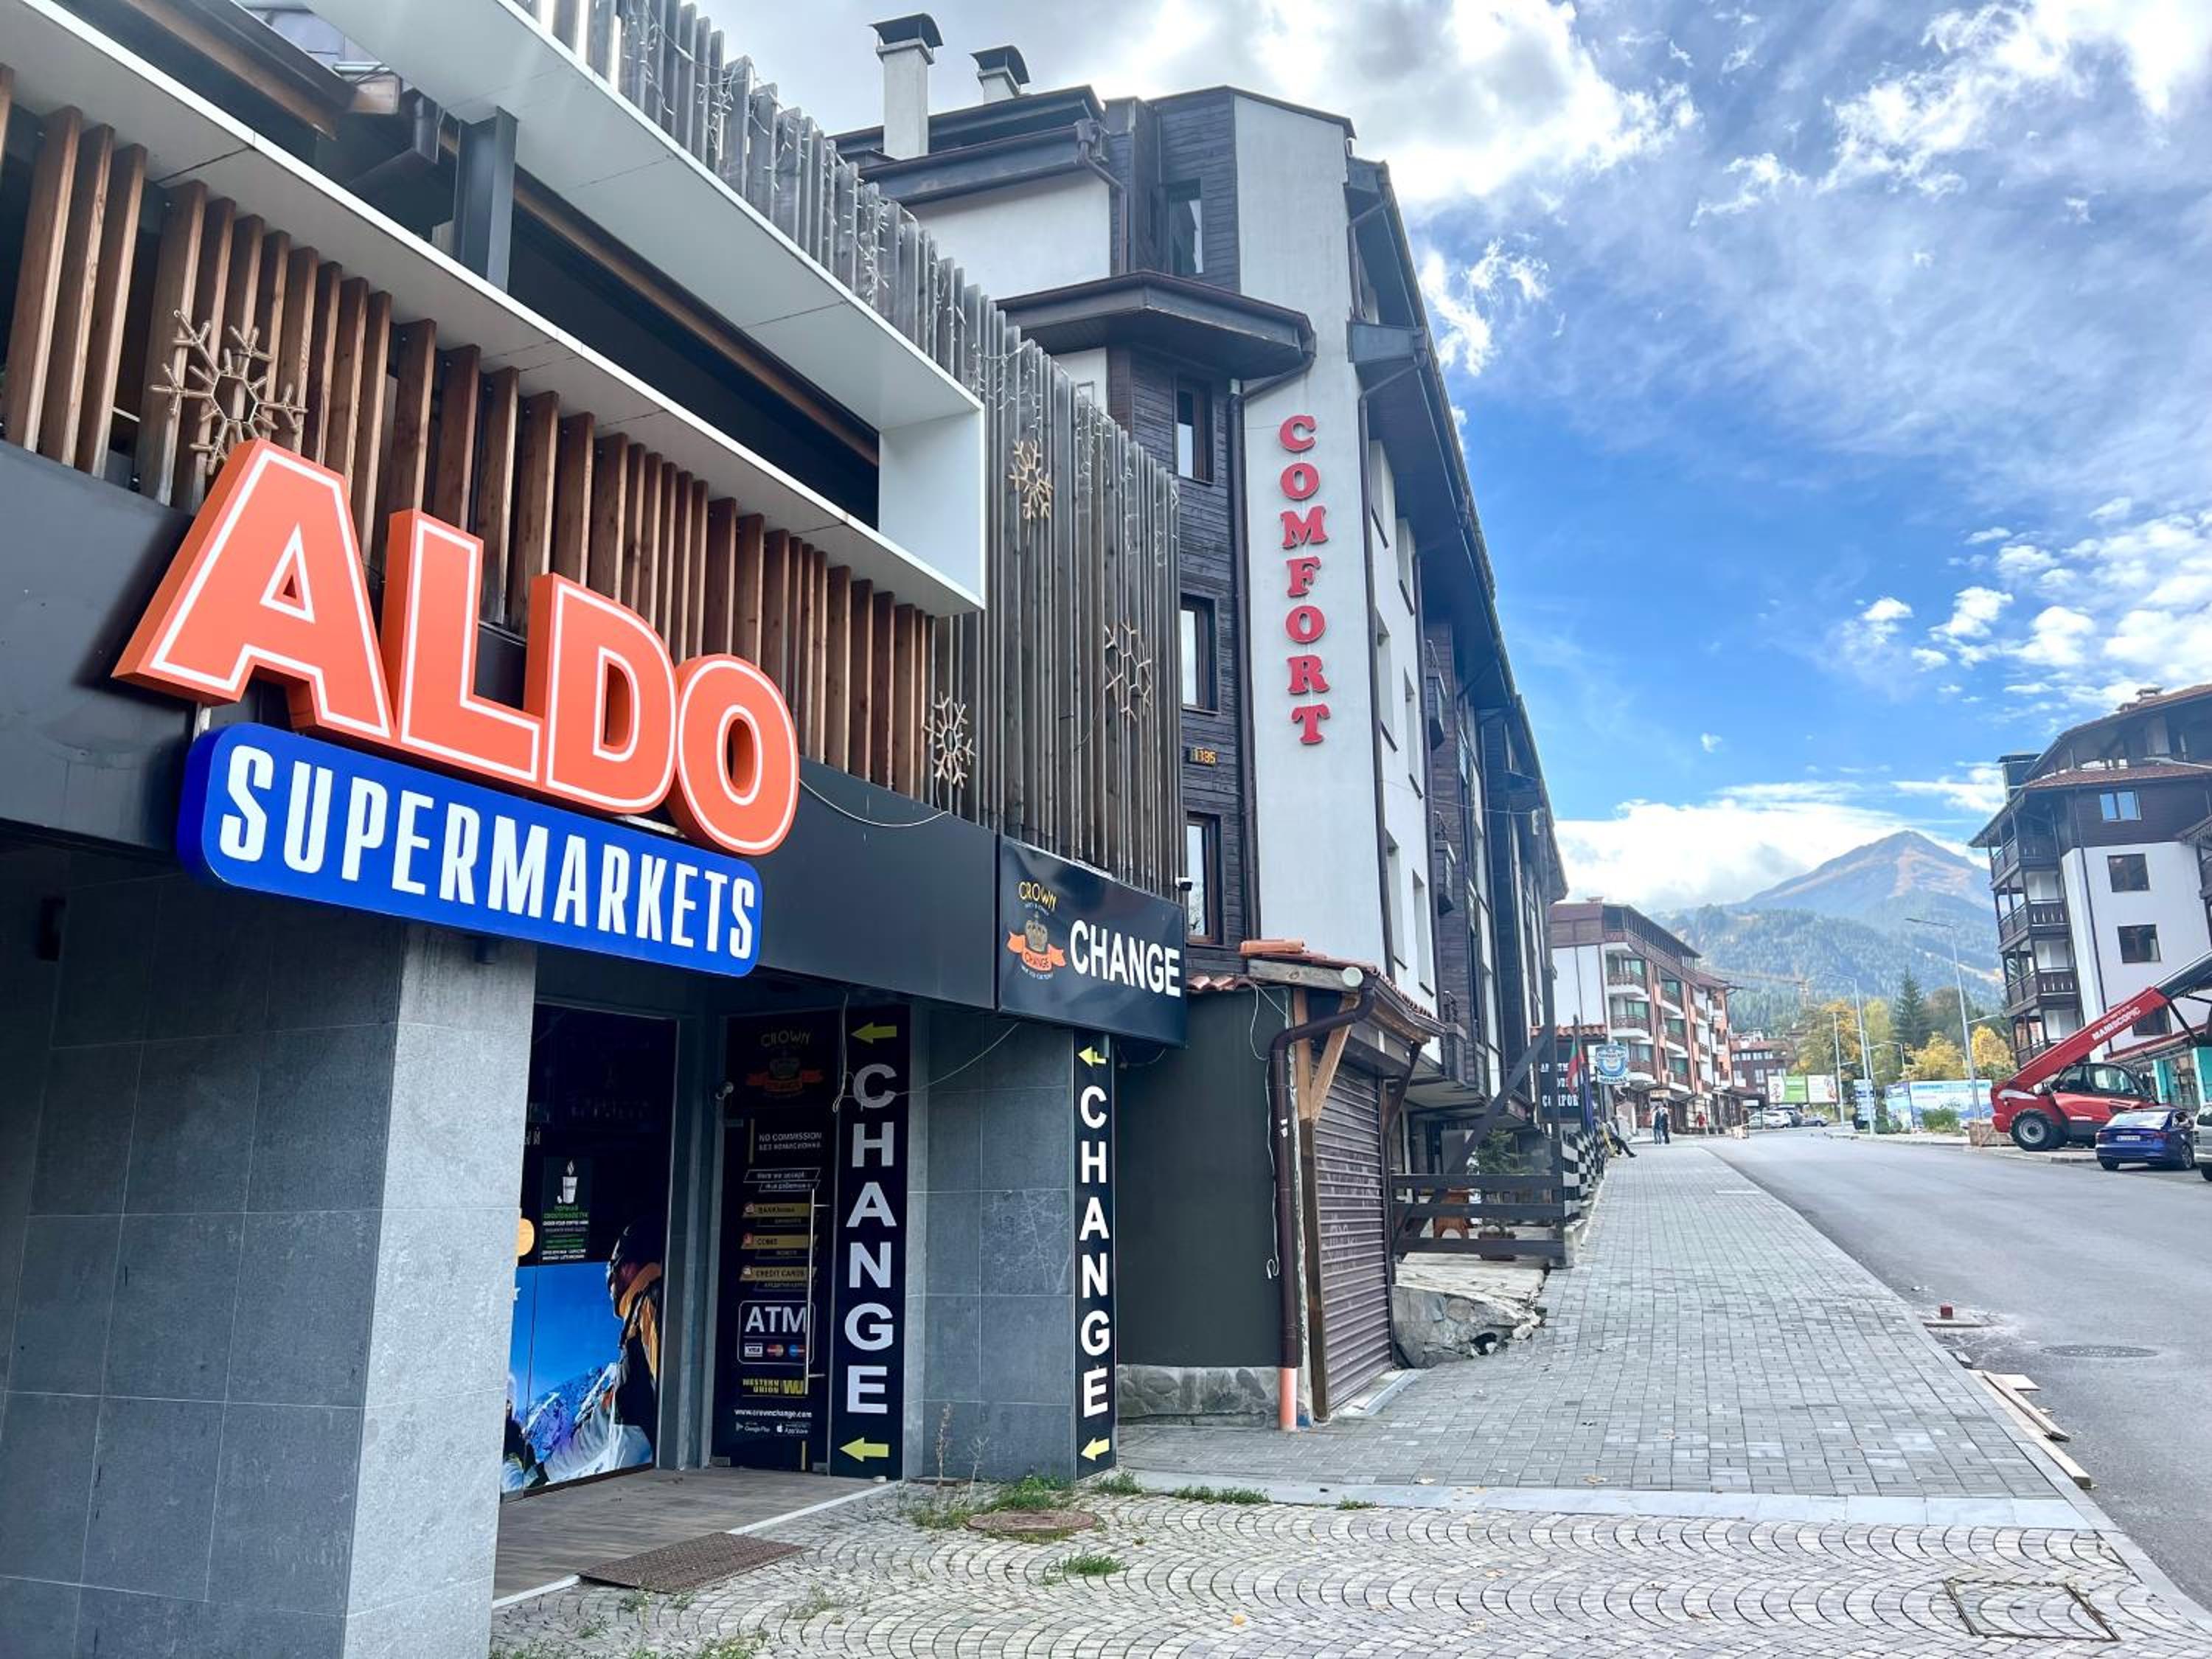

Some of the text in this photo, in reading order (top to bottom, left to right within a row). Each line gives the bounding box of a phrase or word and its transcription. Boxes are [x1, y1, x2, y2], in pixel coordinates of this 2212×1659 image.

[1279, 415, 1329, 745] COMFORT
[114, 437, 799, 856] ALDO
[219, 744, 760, 960] SUPERMARKETS
[1018, 881, 1057, 912] CROWN
[1071, 919, 1181, 998] CHANGE
[761, 1029, 811, 1048] CROWN
[759, 1133, 822, 1142] NO COMMISSION
[846, 1063, 898, 1414] CHANGE
[1079, 1085, 1110, 1417] CHANGE
[745, 1307, 807, 1333] ATM
[742, 1379, 779, 1387] WESTERN
